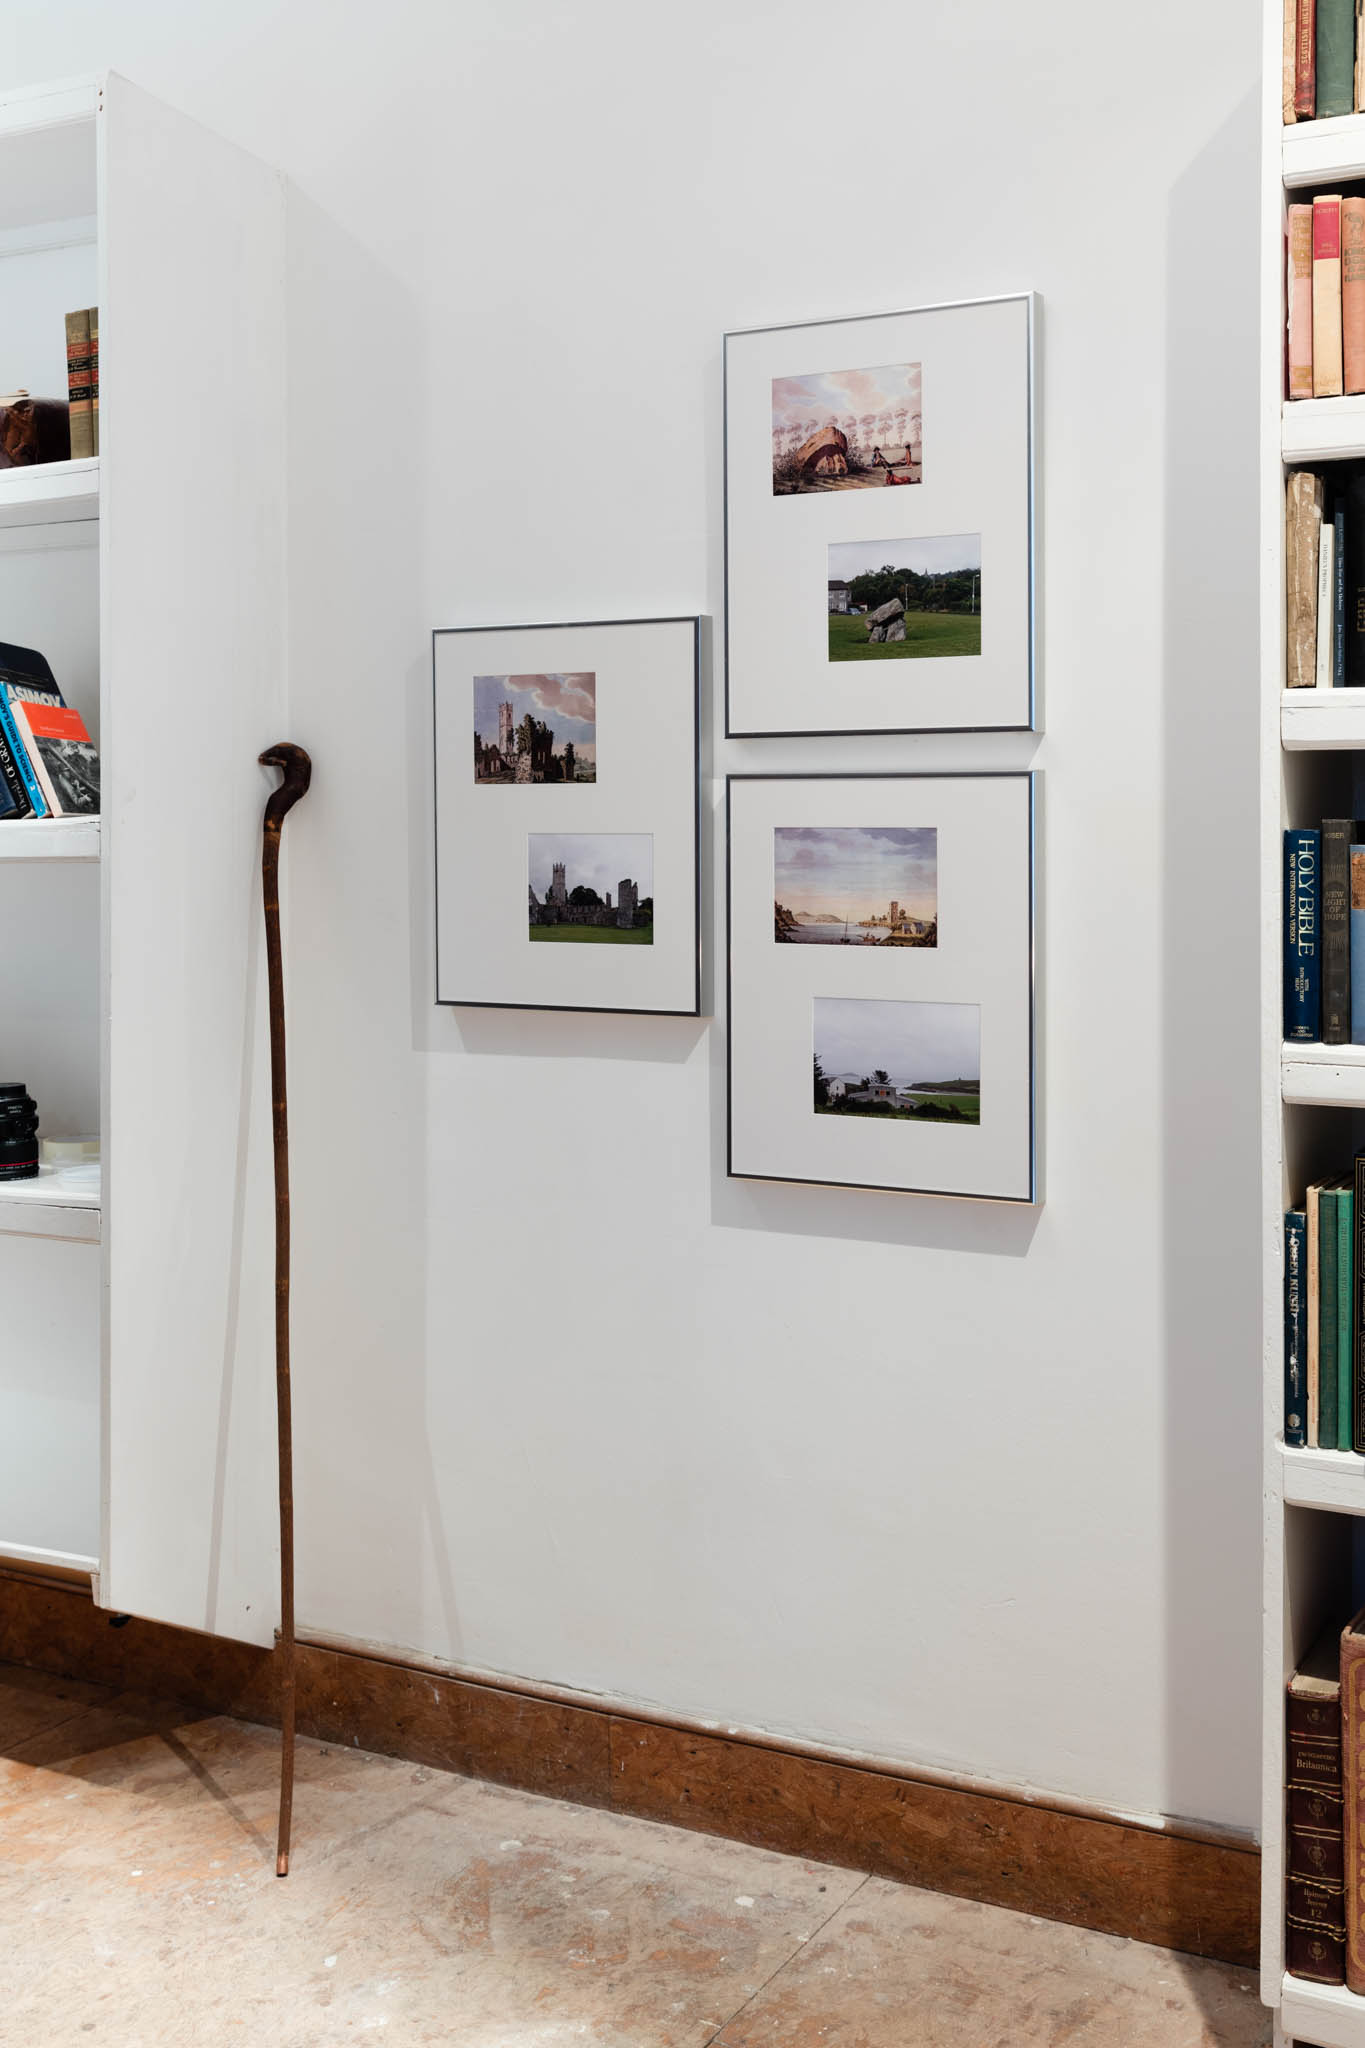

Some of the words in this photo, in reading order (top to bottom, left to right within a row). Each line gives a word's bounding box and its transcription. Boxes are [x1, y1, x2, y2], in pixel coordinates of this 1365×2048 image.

[1301, 29, 1309, 64] SCOTTISH
[7, 684, 60, 708] ASIMOV
[6, 720, 19, 744] GUIDE
[15, 743, 22, 754] TO
[19, 754, 32, 783] SCIENCE
[5, 764, 15, 778] OF
[1298, 839, 1314, 894] HOLY
[1298, 896, 1314, 956] BIBLE
[1296, 1758, 1337, 1773] Britannica
